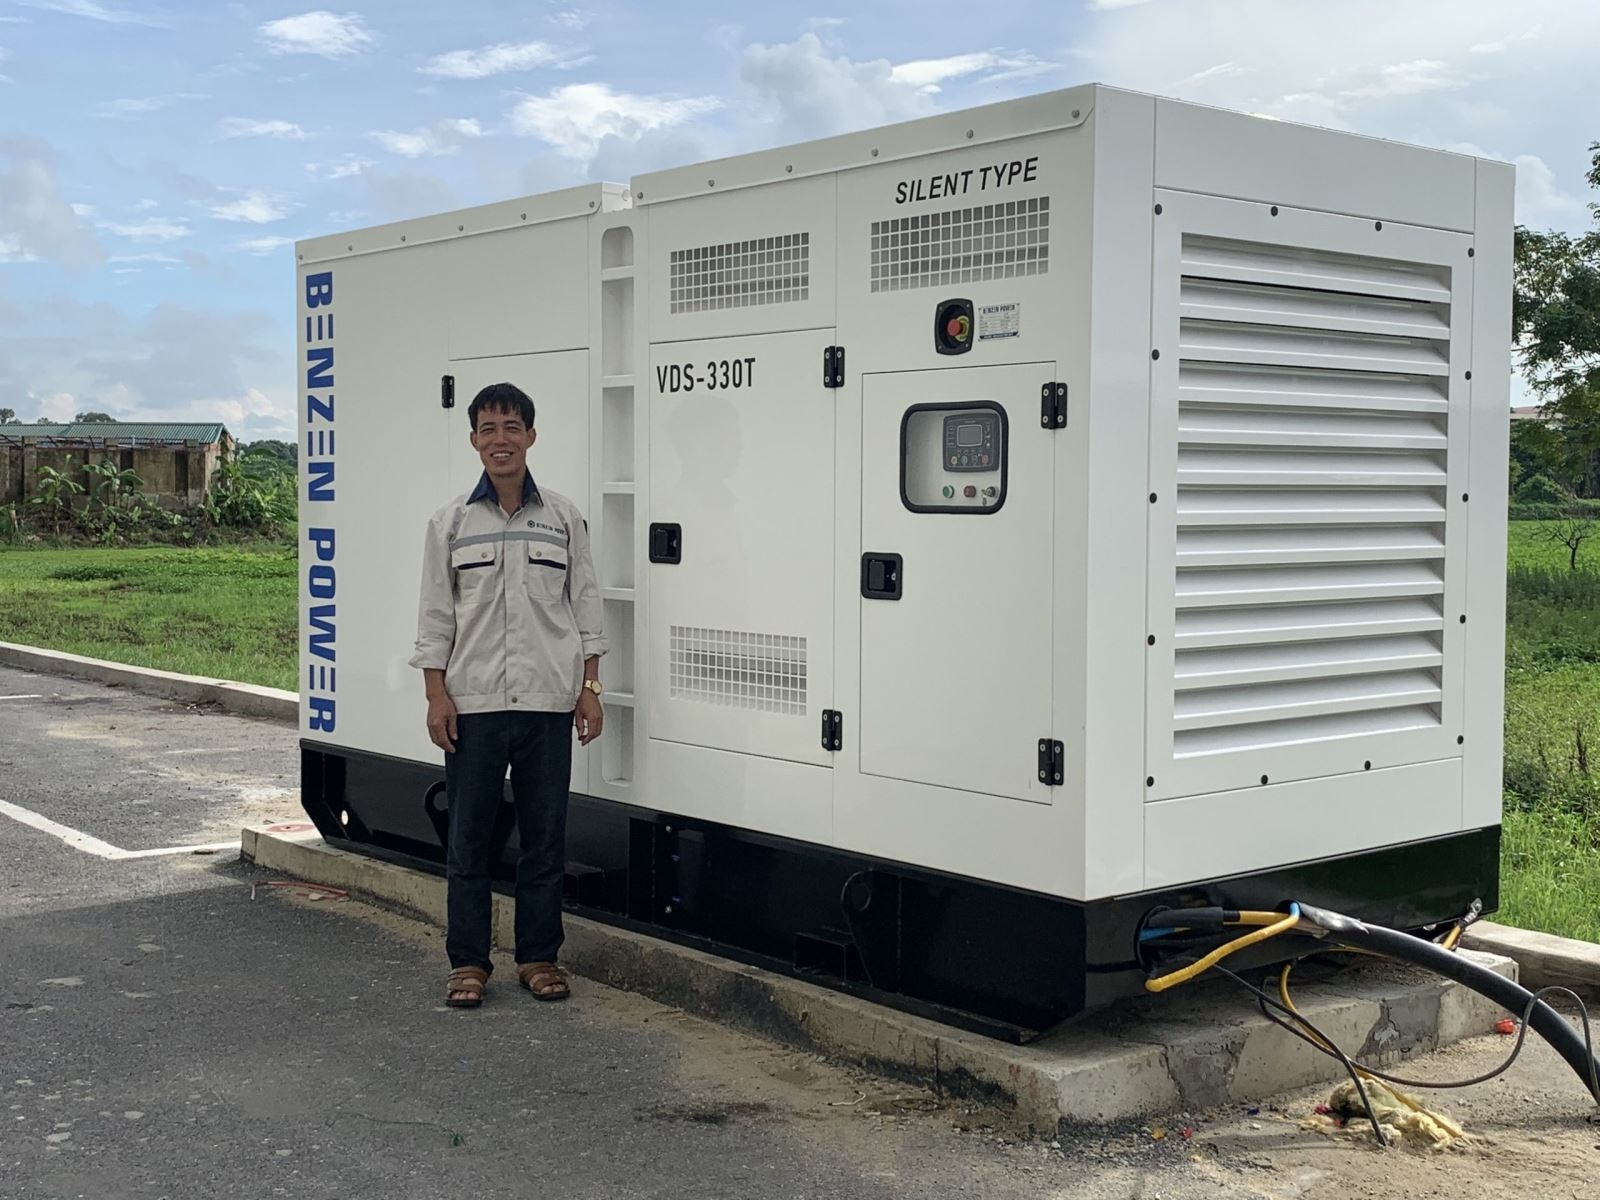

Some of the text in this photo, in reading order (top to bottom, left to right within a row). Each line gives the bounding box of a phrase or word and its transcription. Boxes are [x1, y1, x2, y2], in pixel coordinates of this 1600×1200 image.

[896, 156, 1039, 205] SILENT TYPE
[656, 357, 756, 393] VDS-330T
[306, 271, 337, 733] BENZEN POWER
